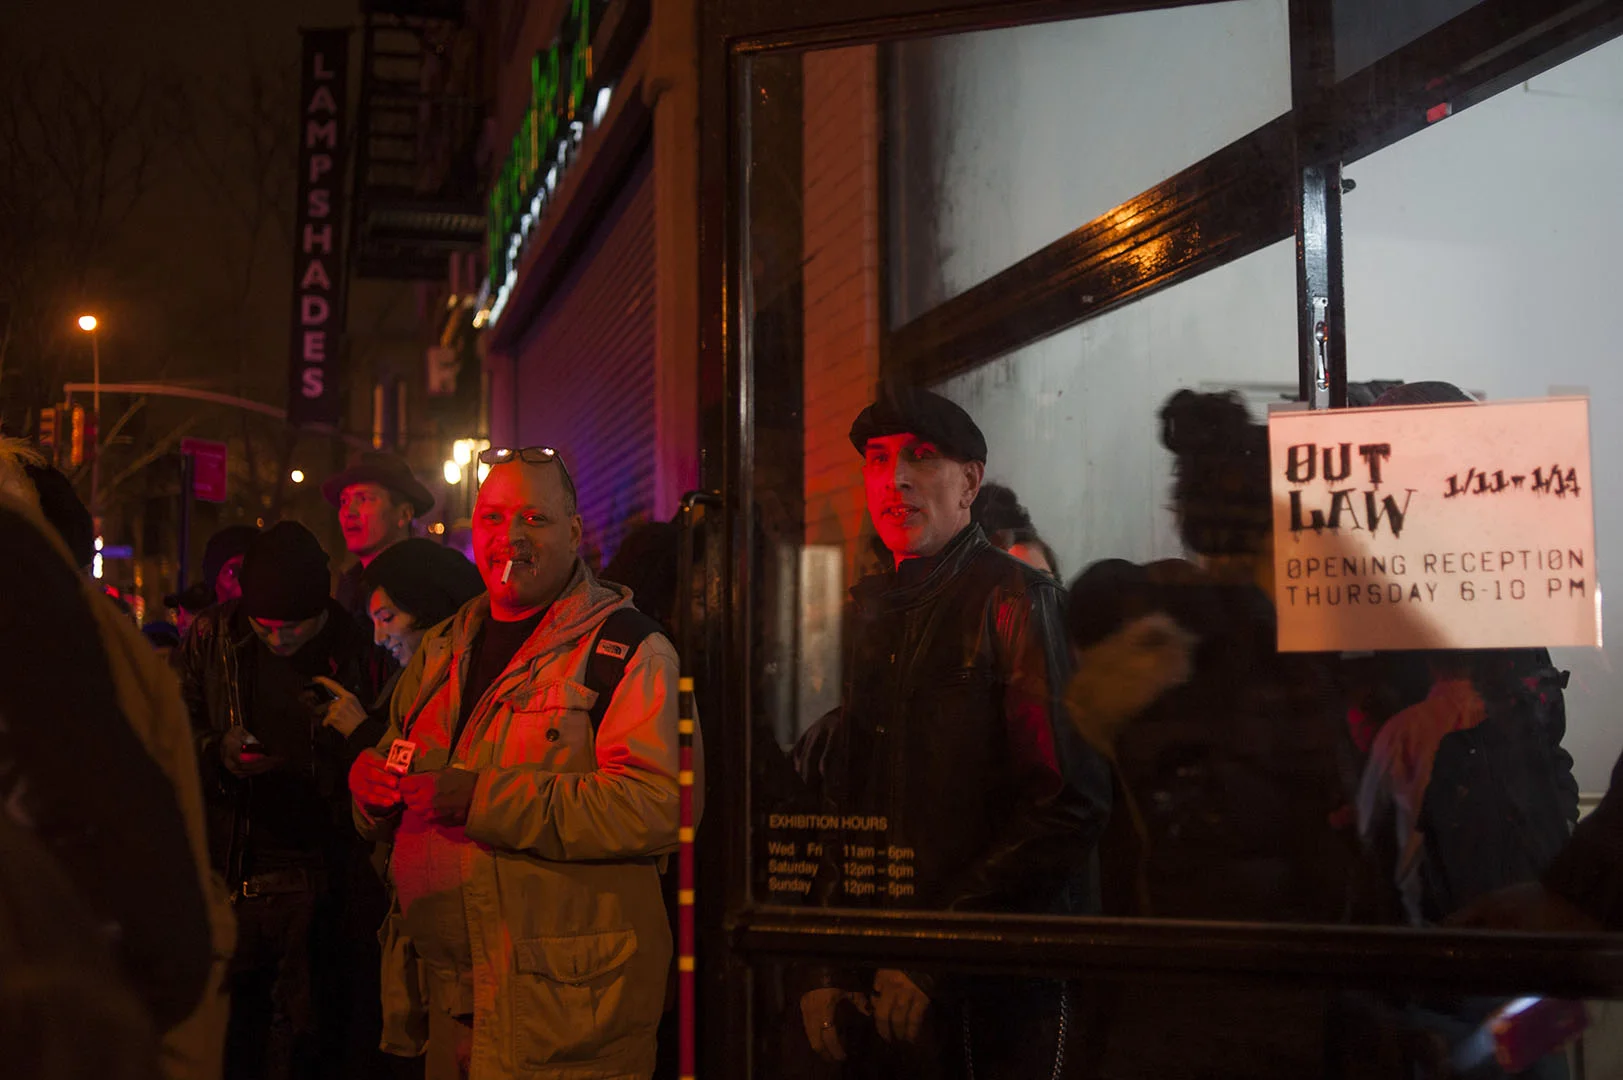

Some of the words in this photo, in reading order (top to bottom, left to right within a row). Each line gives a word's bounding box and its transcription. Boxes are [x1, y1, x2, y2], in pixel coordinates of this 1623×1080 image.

[301, 52, 337, 399] LAMPSHADES
[1288, 488, 1417, 541] LAW
[1286, 582, 1438, 606] THURSDAY
[1547, 577, 1586, 599] PM
[769, 813, 839, 829] EXHIBITION
[841, 815, 888, 831] HOURS
[768, 840, 796, 857] Wed
[806, 841, 824, 857] Fri
[843, 843, 876, 857] 11am
[768, 858, 819, 877] Saturday
[844, 862, 876, 878] 12pm
[768, 876, 812, 896] Sunday
[844, 879, 876, 896] 12pm
